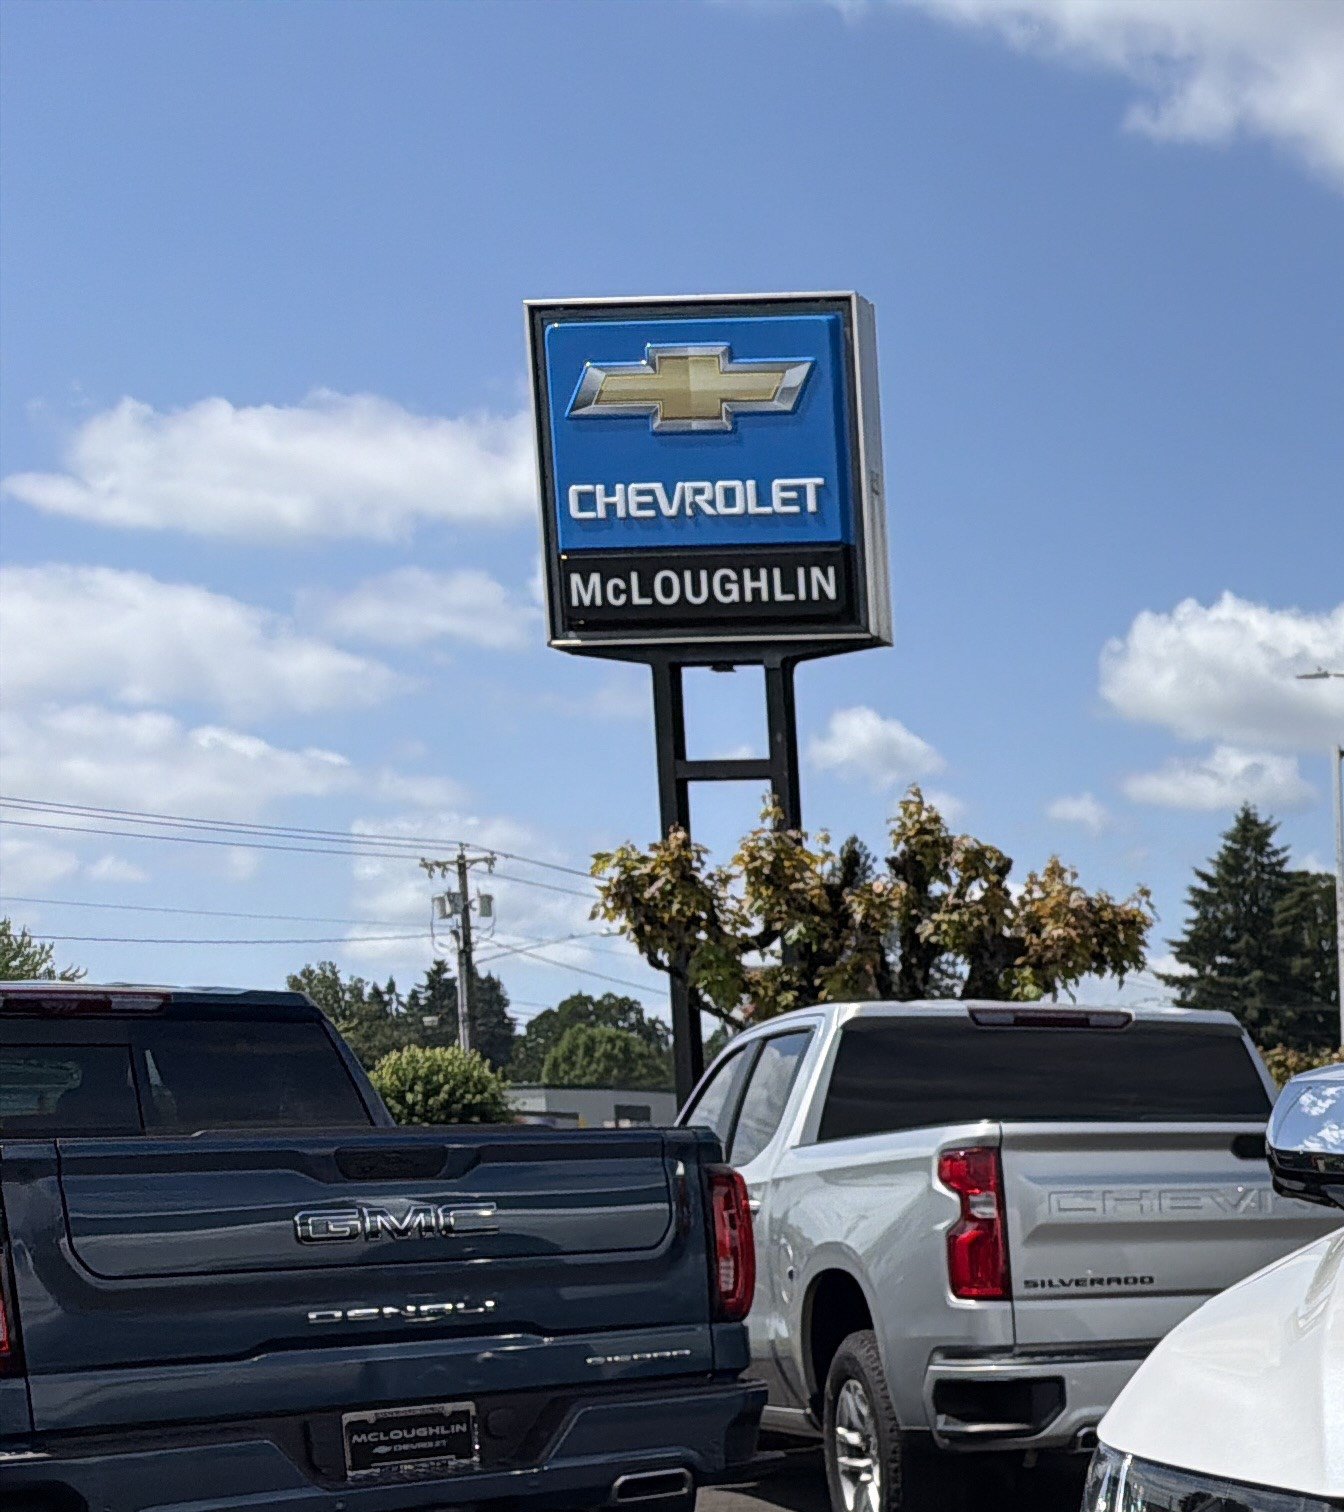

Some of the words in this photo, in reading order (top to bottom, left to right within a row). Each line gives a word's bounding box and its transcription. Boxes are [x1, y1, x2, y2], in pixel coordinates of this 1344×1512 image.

[569, 477, 825, 520] CHEVROLET
[570, 566, 837, 607] McLOUGHLIN
[294, 1202, 500, 1246] GMC
[1023, 1275, 1155, 1290] SILVERADO
[351, 1422, 468, 1444] MCLOUGHLIN
